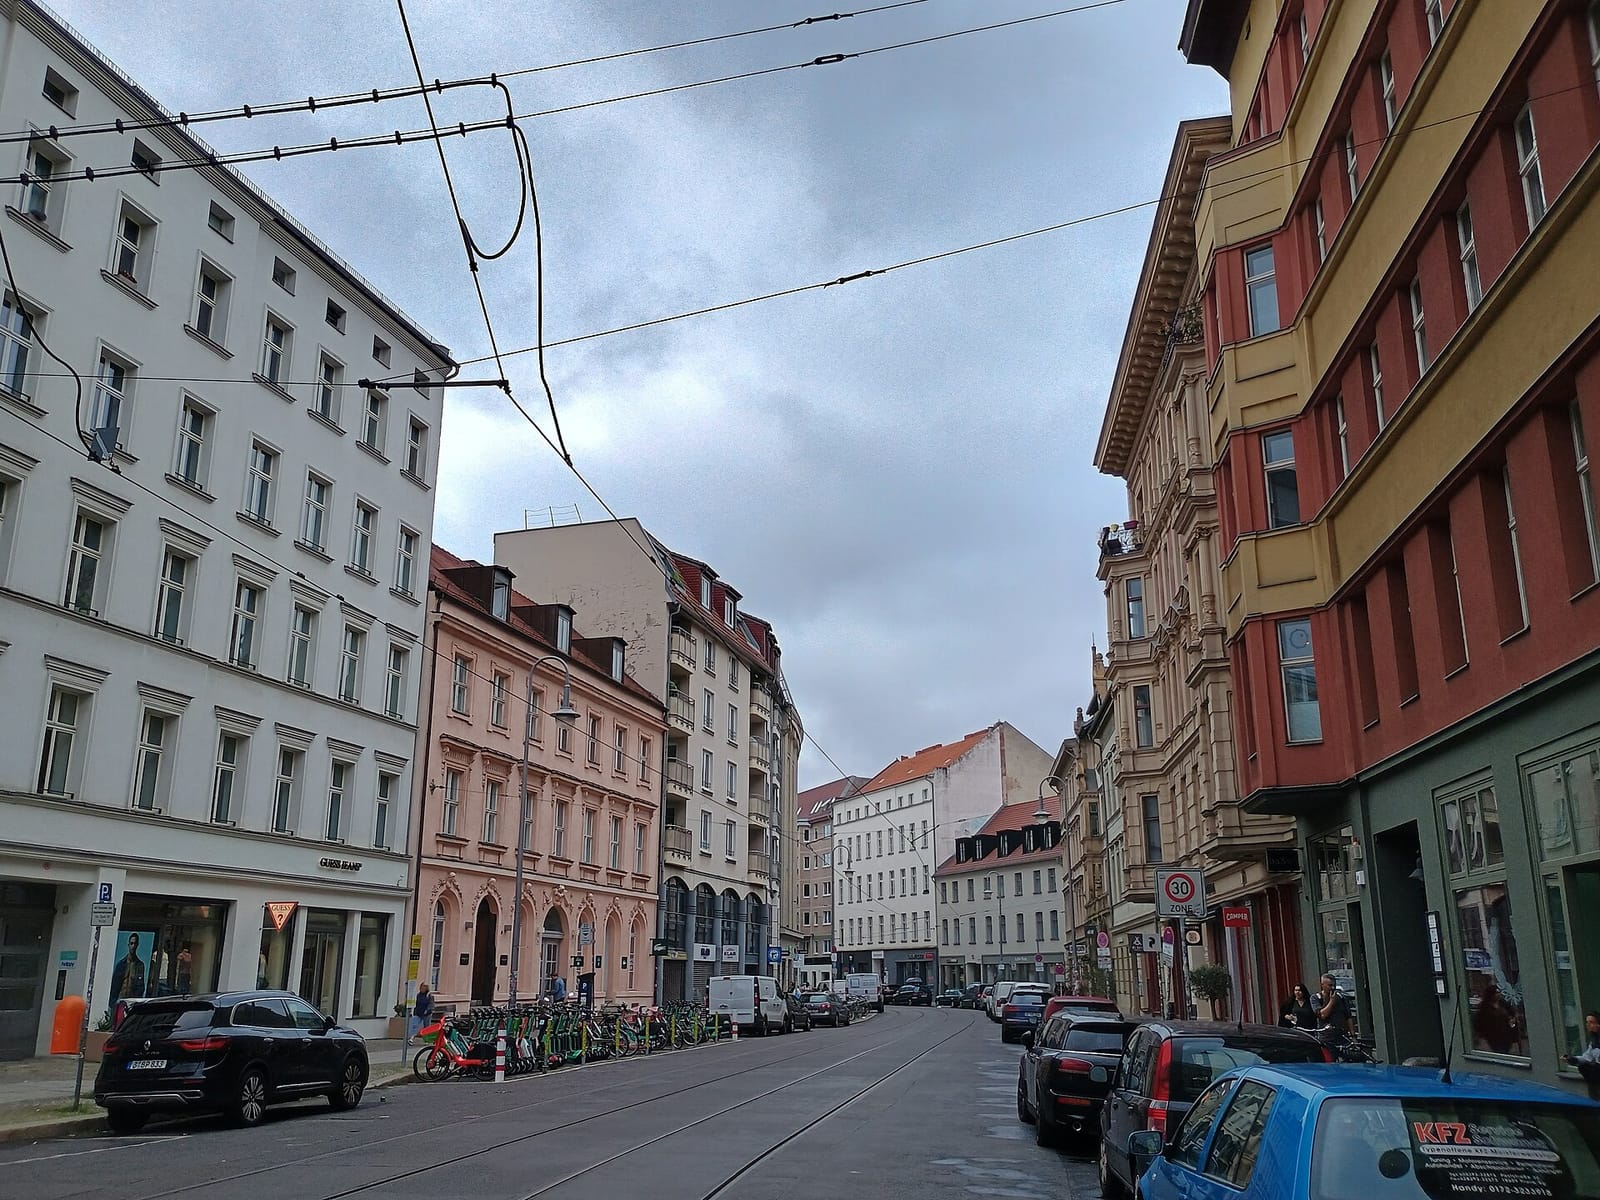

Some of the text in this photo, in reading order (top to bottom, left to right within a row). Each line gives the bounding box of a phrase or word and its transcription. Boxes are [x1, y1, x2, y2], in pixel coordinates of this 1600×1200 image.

[320, 857, 341, 869] GUESS
[101, 885, 109, 899] P
[1171, 882, 1189, 895] 30
[277, 914, 284, 926] ?
[1226, 912, 1248, 920] CAMPER
[1414, 1122, 1472, 1144] KFZ
[1451, 1184, 1487, 1193] Handy:
